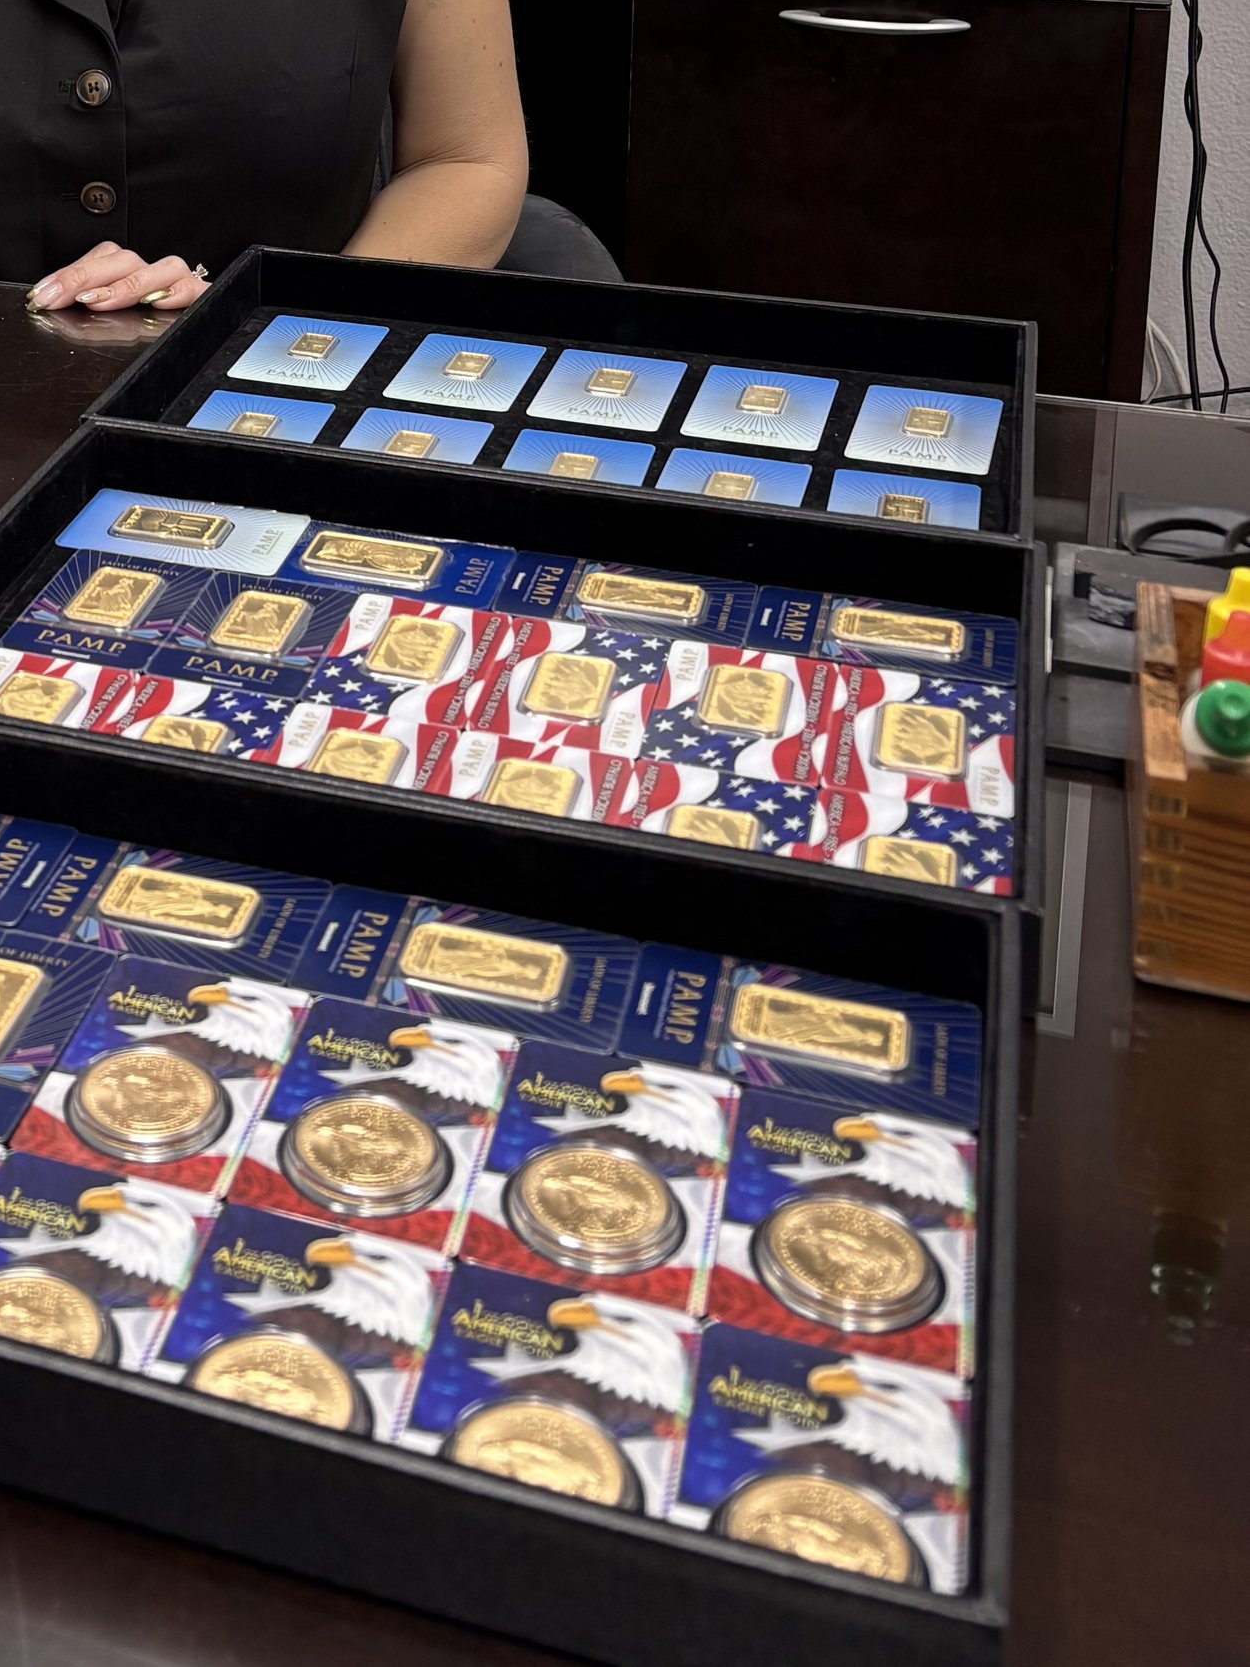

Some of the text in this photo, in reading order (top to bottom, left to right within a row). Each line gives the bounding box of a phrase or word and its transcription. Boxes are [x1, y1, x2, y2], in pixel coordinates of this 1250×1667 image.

[444, 693, 463, 725] AMERICA
[467, 641, 490, 673] AMERICAN
[485, 616, 502, 644] BUFFALO
[427, 730, 449, 760] BUFFALO
[0, 945, 17, 956] OF
[19, 949, 71, 968] LIBERTY
[108, 991, 196, 1020] AMERICAN
[307, 1035, 400, 1065] AMERICAN
[516, 1079, 615, 1112] AMERICAN
[747, 1124, 851, 1159] AMERICAN
[212, 1246, 317, 1287] AMERICAN
[451, 1308, 564, 1352] AMERICAN
[708, 1375, 828, 1421] AMERICAN
